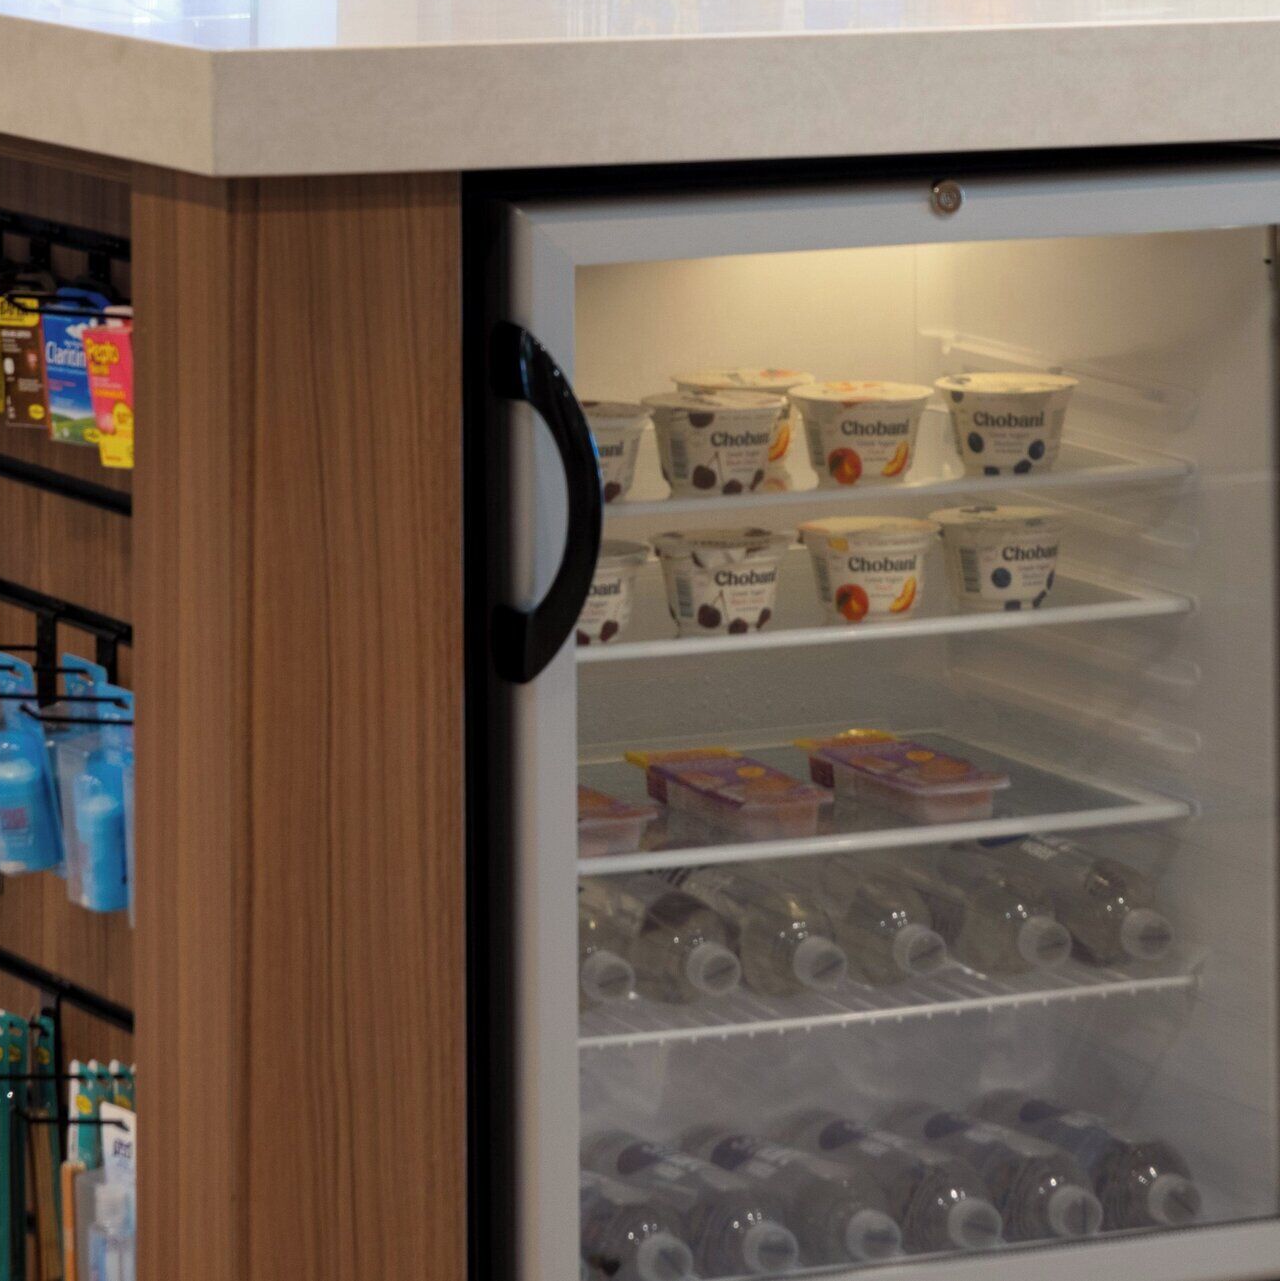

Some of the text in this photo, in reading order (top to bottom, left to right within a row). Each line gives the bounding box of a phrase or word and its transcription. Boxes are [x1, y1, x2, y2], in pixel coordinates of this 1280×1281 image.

[841, 418, 910, 437] Chobani
[973, 410, 1045, 428] Chobani
[848, 554, 917, 573] Chobani
